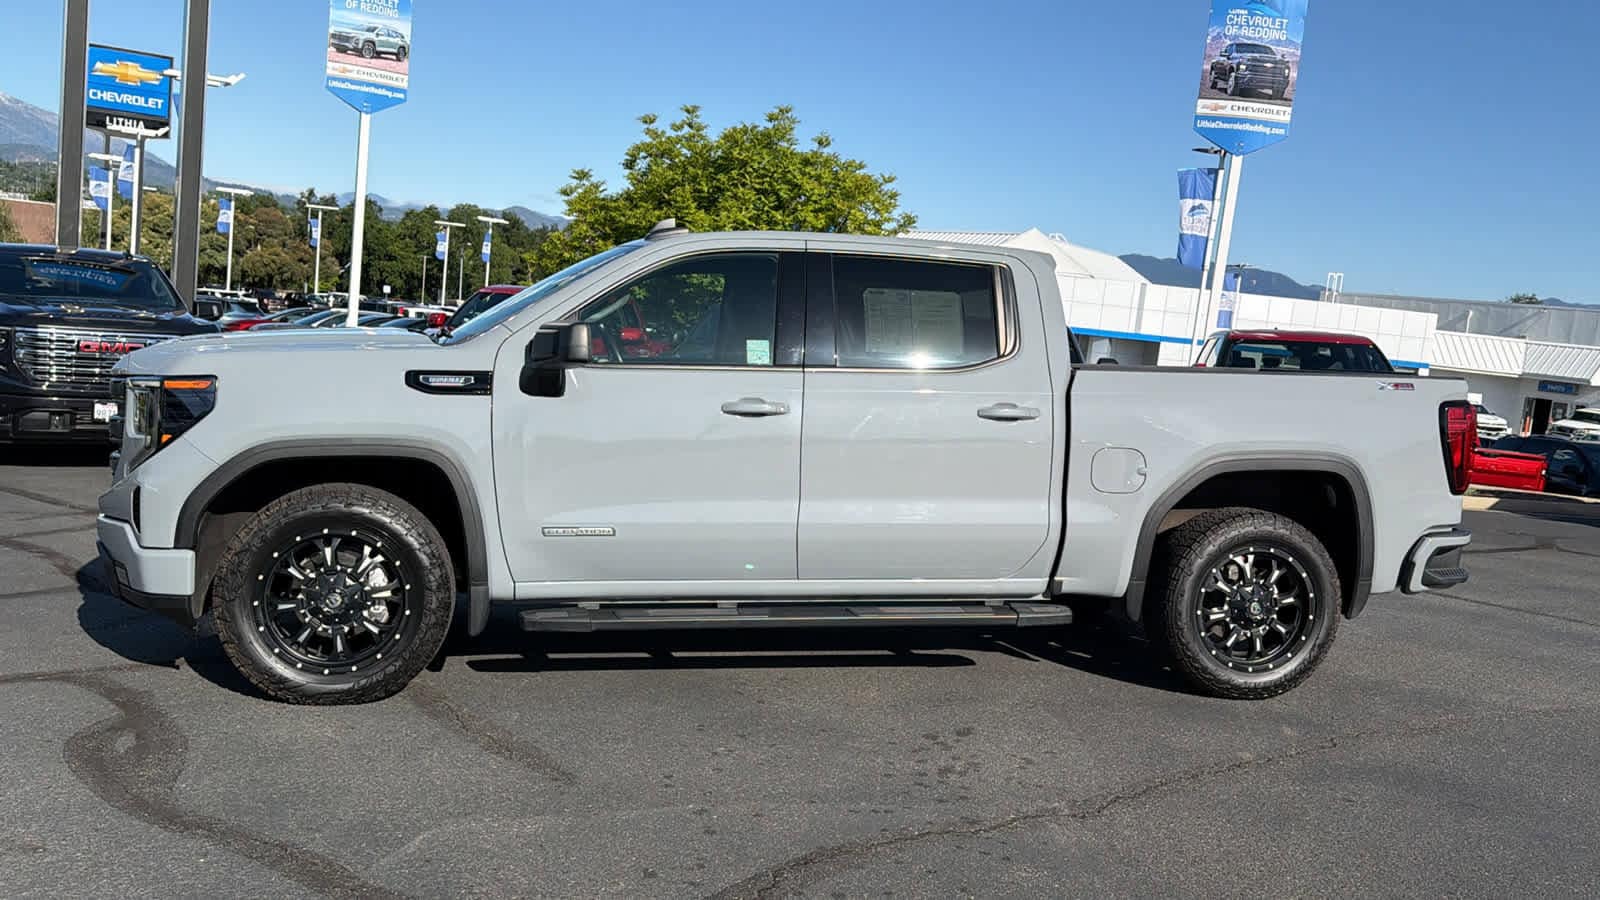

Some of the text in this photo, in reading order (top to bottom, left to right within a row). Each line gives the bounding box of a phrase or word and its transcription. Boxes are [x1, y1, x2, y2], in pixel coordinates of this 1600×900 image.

[346, 0, 398, 17] OF REDDING
[1226, 15, 1289, 29] CHEVROLET
[1225, 25, 1288, 41] OF REDDING
[356, 70, 404, 83] CHEVROLET
[89, 89, 164, 109] CHEVROLET
[1230, 104, 1288, 117] CHEVROLET
[105, 116, 145, 130] LITHIA
[1196, 119, 1286, 136] LithiaChevroletRedding.com
[79, 341, 145, 352] GMC
